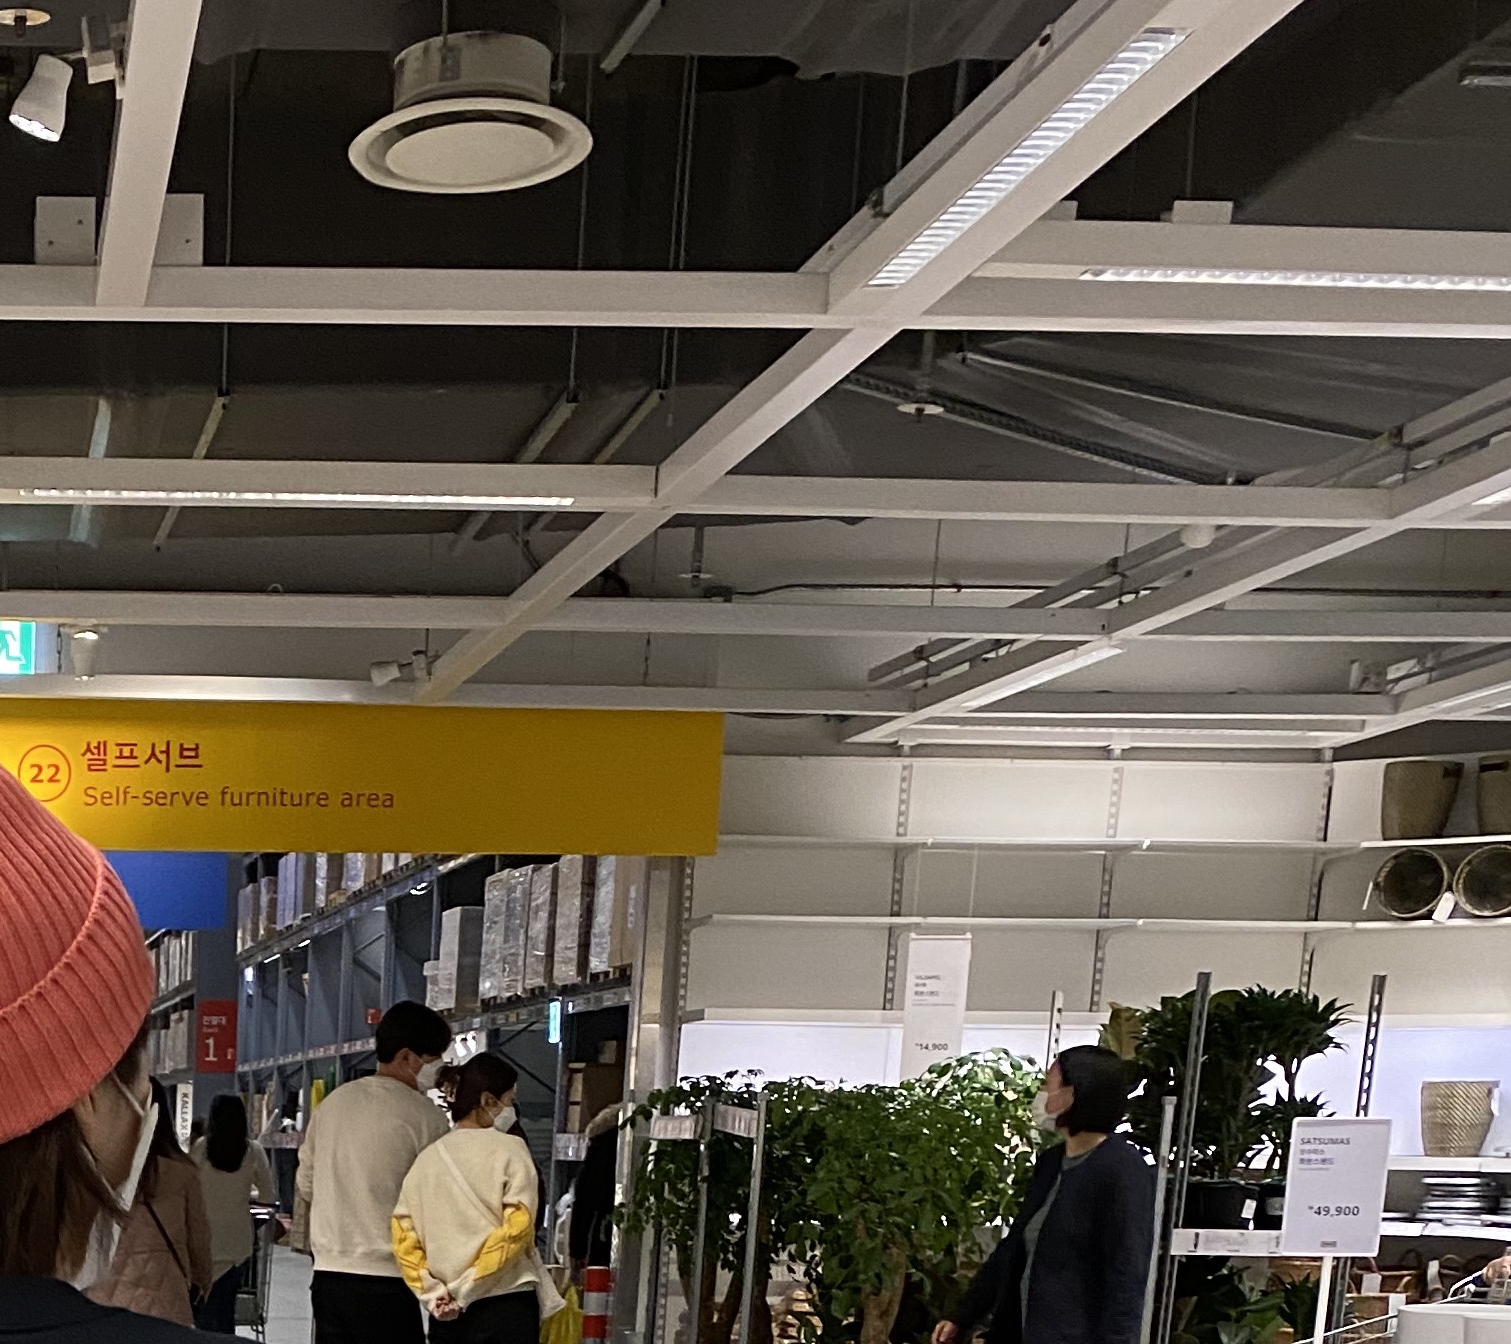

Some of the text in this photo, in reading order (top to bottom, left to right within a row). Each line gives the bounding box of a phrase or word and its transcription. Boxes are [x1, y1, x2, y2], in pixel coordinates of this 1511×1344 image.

[81, 740, 203, 773] 셀프서브
[29, 763, 61, 784] 22
[83, 786, 394, 808] Self-serve furniture area
[204, 1036, 218, 1062] 1
